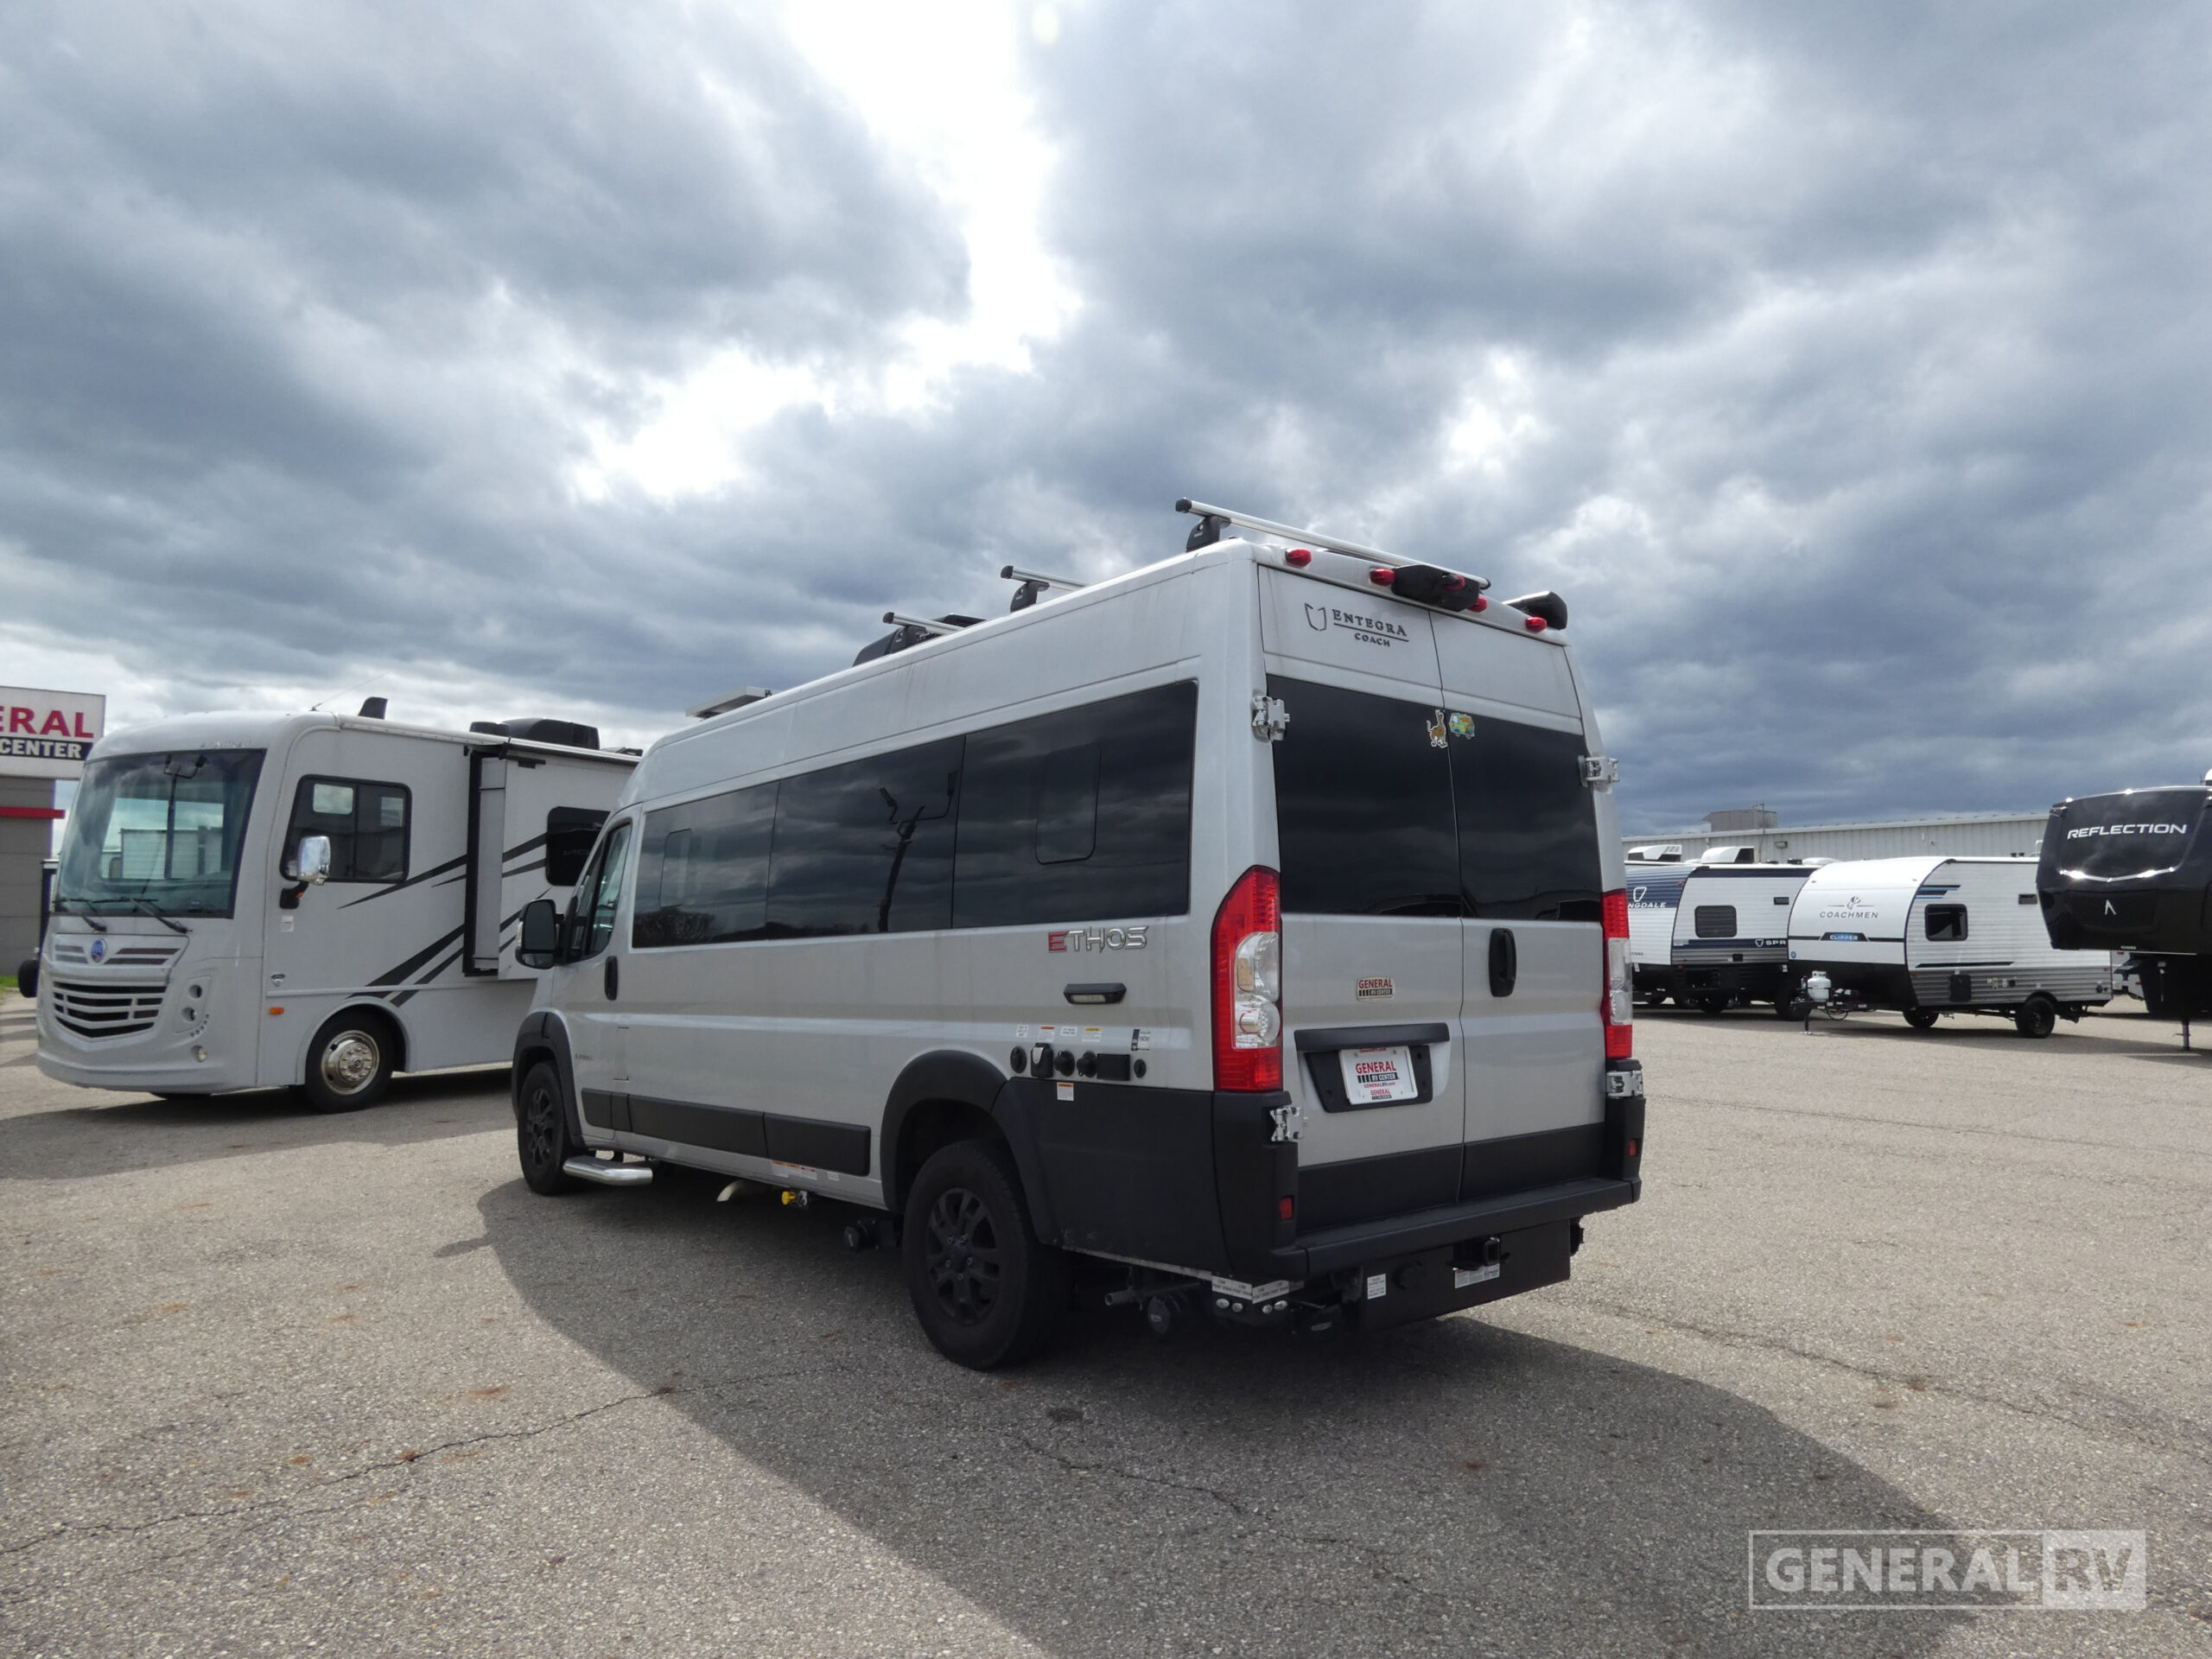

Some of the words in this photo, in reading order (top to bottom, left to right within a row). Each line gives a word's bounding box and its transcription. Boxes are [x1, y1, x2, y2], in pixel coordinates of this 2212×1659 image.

[1332, 608, 1408, 637] ENTEGRA
[1354, 632, 1391, 647] COACH
[0, 705, 94, 739] RAL
[0, 738, 82, 759] CENTER
[2067, 823, 2188, 840] REFLECTION
[1048, 925, 1149, 953] ETHOS
[1358, 978, 1393, 989] GENERAL
[1355, 1060, 1396, 1074] GENERAL
